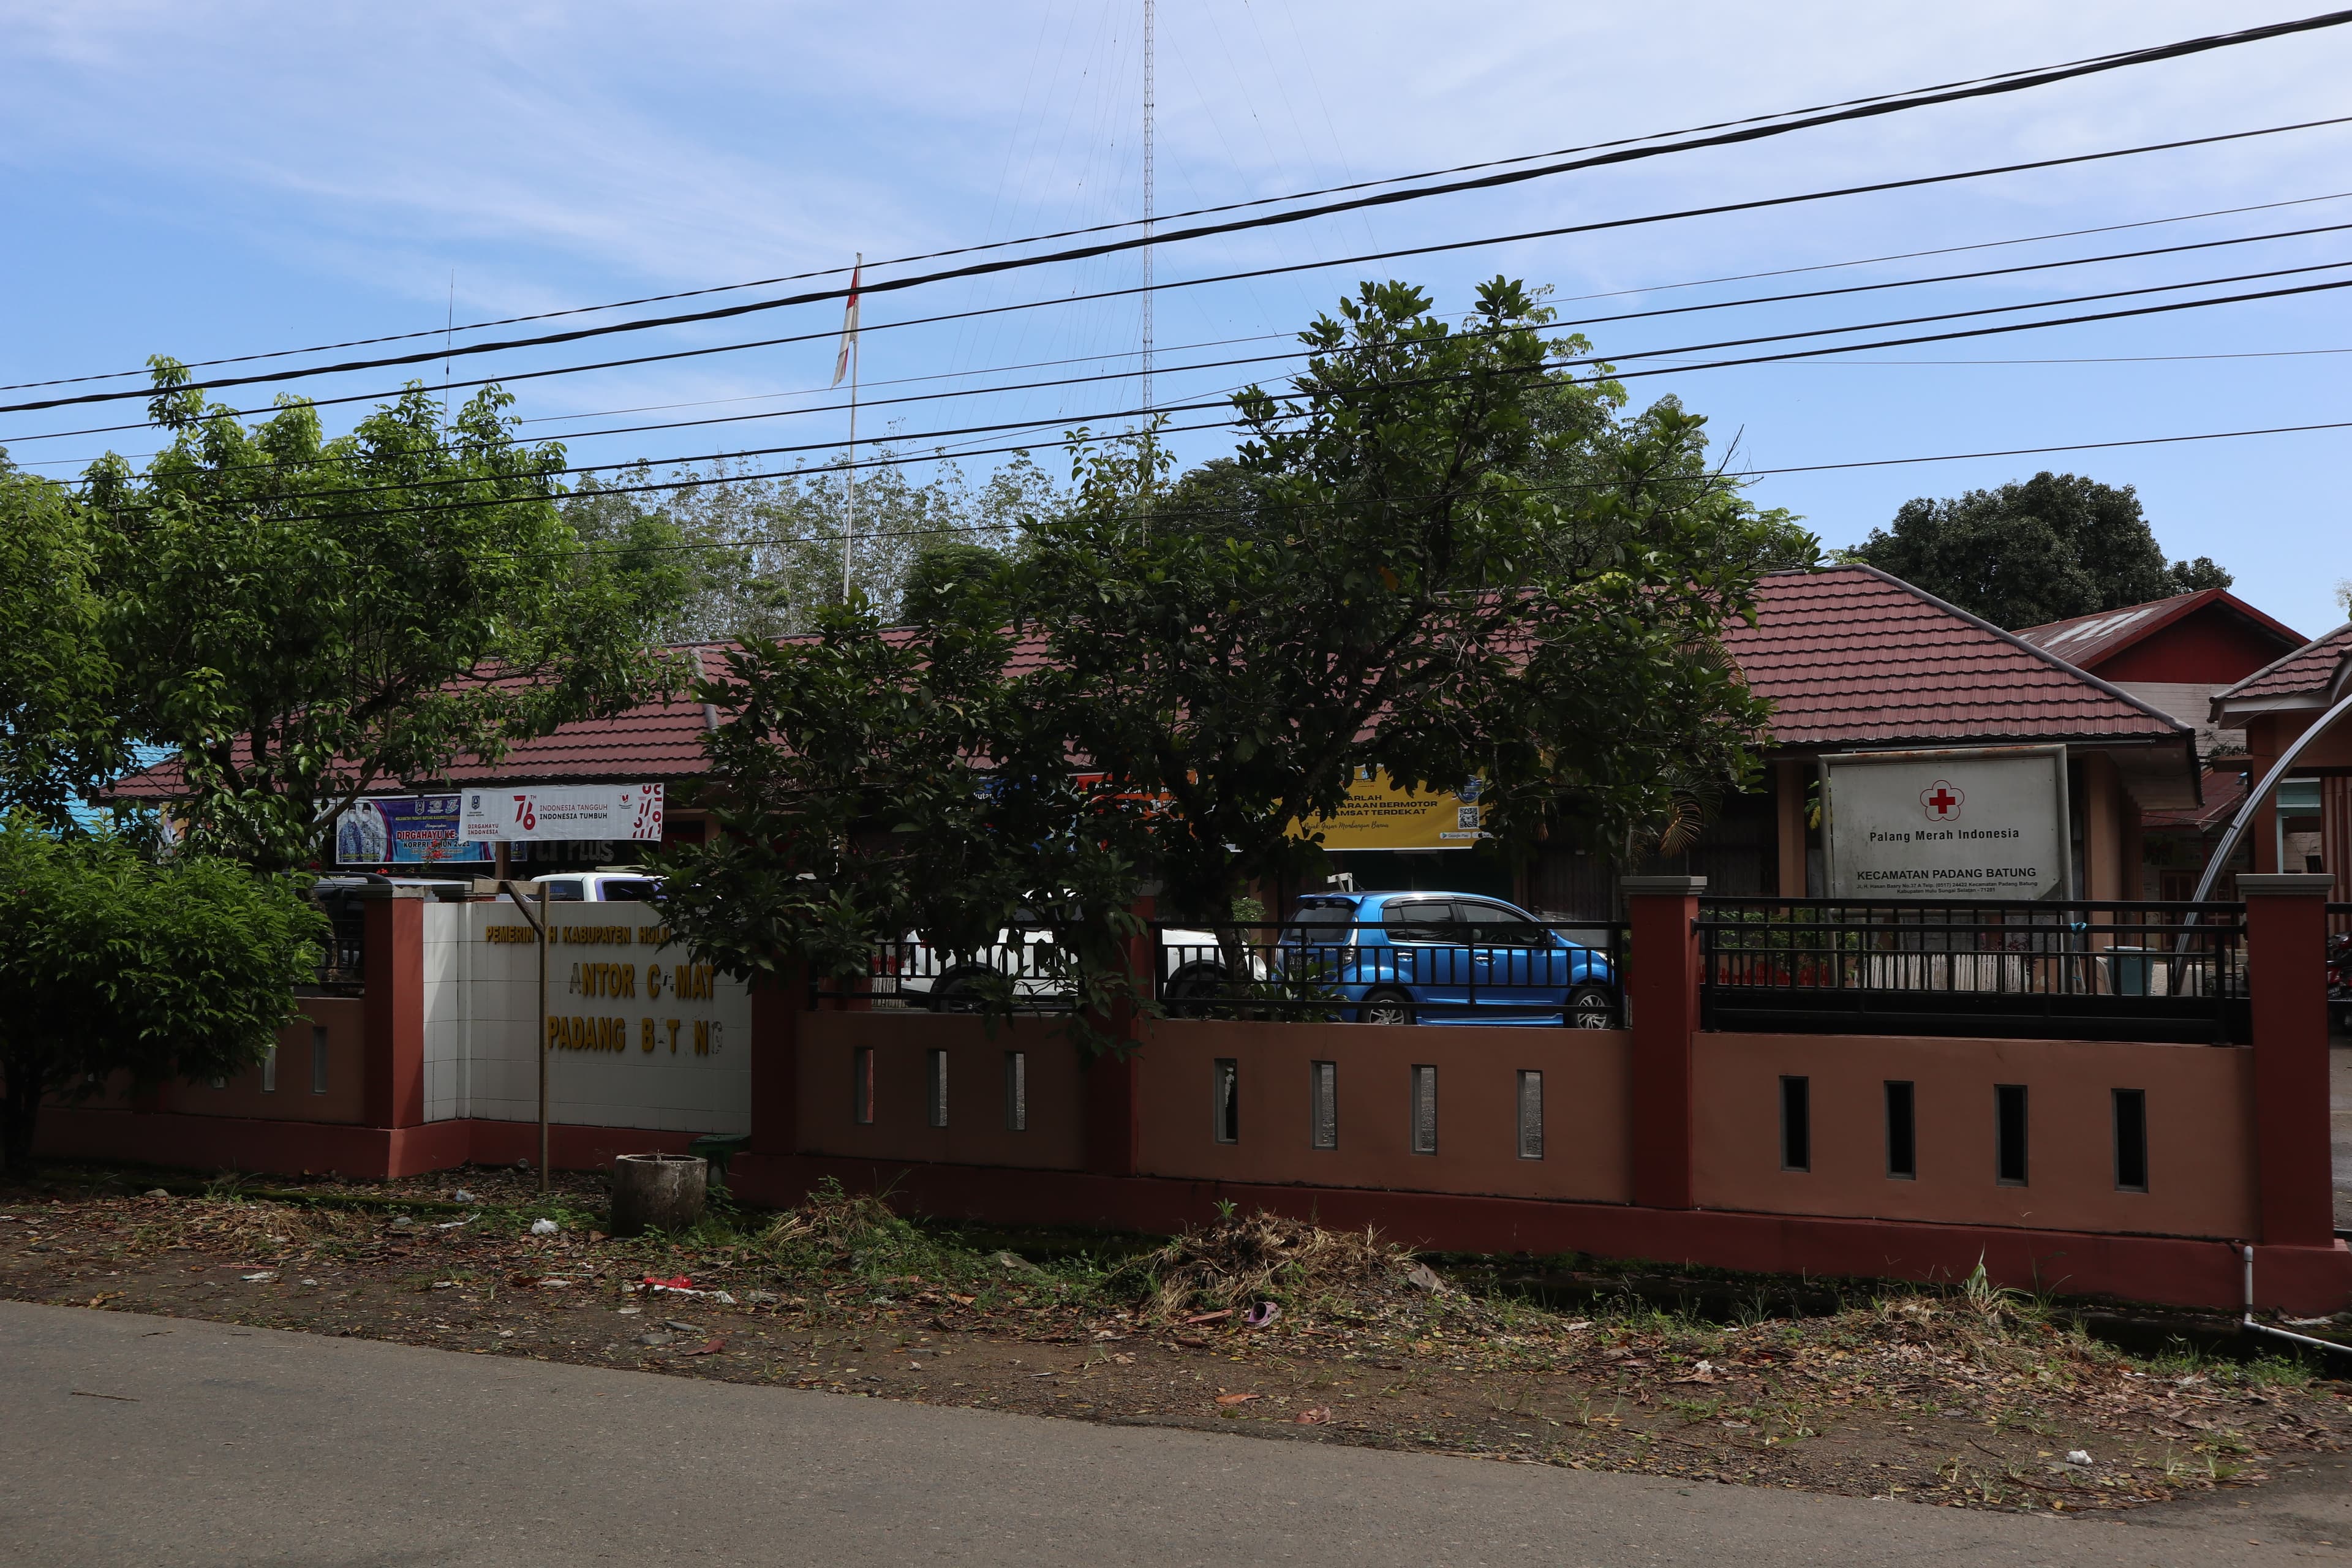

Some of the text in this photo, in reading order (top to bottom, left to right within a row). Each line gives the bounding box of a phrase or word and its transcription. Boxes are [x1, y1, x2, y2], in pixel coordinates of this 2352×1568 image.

[397, 830, 442, 839] DIRGAHAYU
[1870, 828, 2019, 843] Palang Merah Indonesia
[1857, 867, 2037, 881] KECAMATAN PADANG BATUNG
[486, 926, 558, 944] PEMERINH
[563, 926, 631, 944] KABUPATEN
[647, 963, 715, 1000] CMAT
[547, 1016, 626, 1051] PADANG
